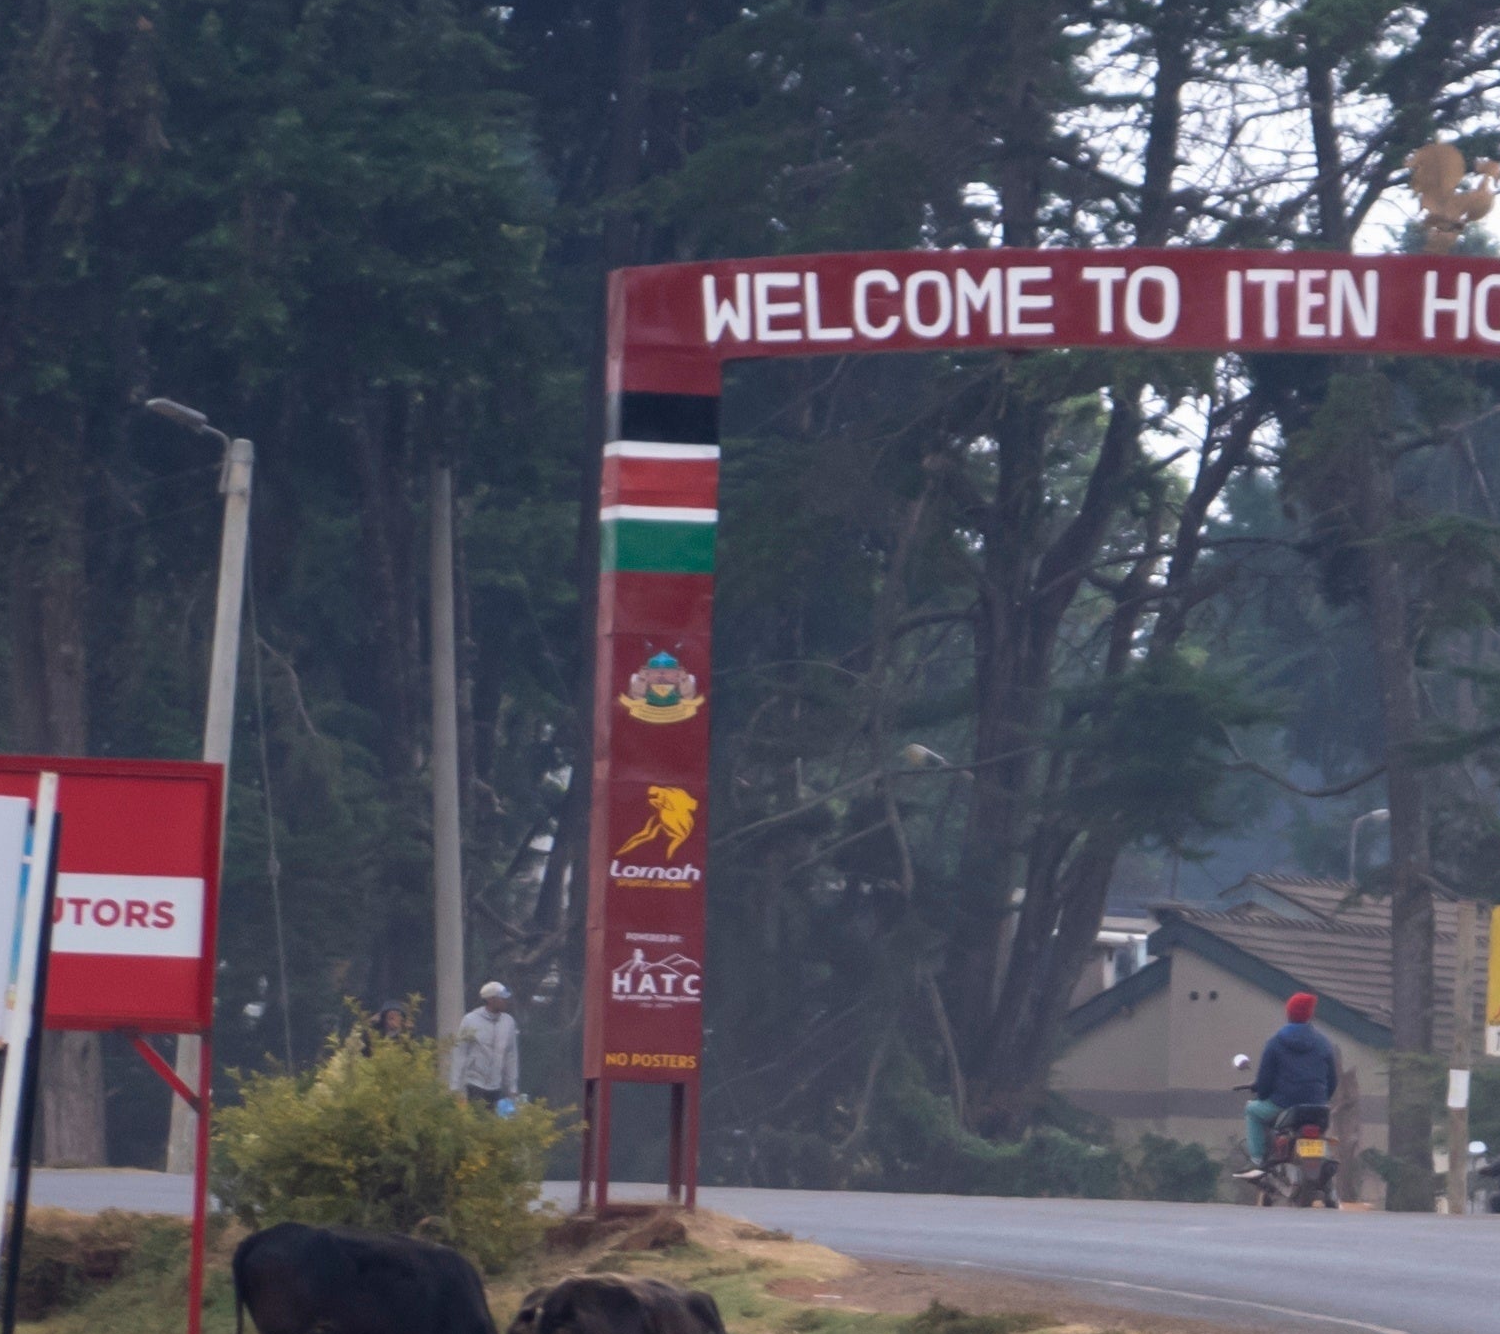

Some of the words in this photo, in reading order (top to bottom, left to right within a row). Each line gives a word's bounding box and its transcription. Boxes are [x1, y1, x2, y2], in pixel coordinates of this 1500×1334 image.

[702, 266, 1055, 344] WELCOME
[1082, 265, 1182, 340] TO
[1226, 269, 1380, 342] ITEN
[609, 859, 701, 881] Lornah
[52, 897, 176, 930] TORS
[611, 972, 701, 995] HATC
[605, 1052, 629, 1066] NO
[631, 1053, 697, 1069] POSTERS
